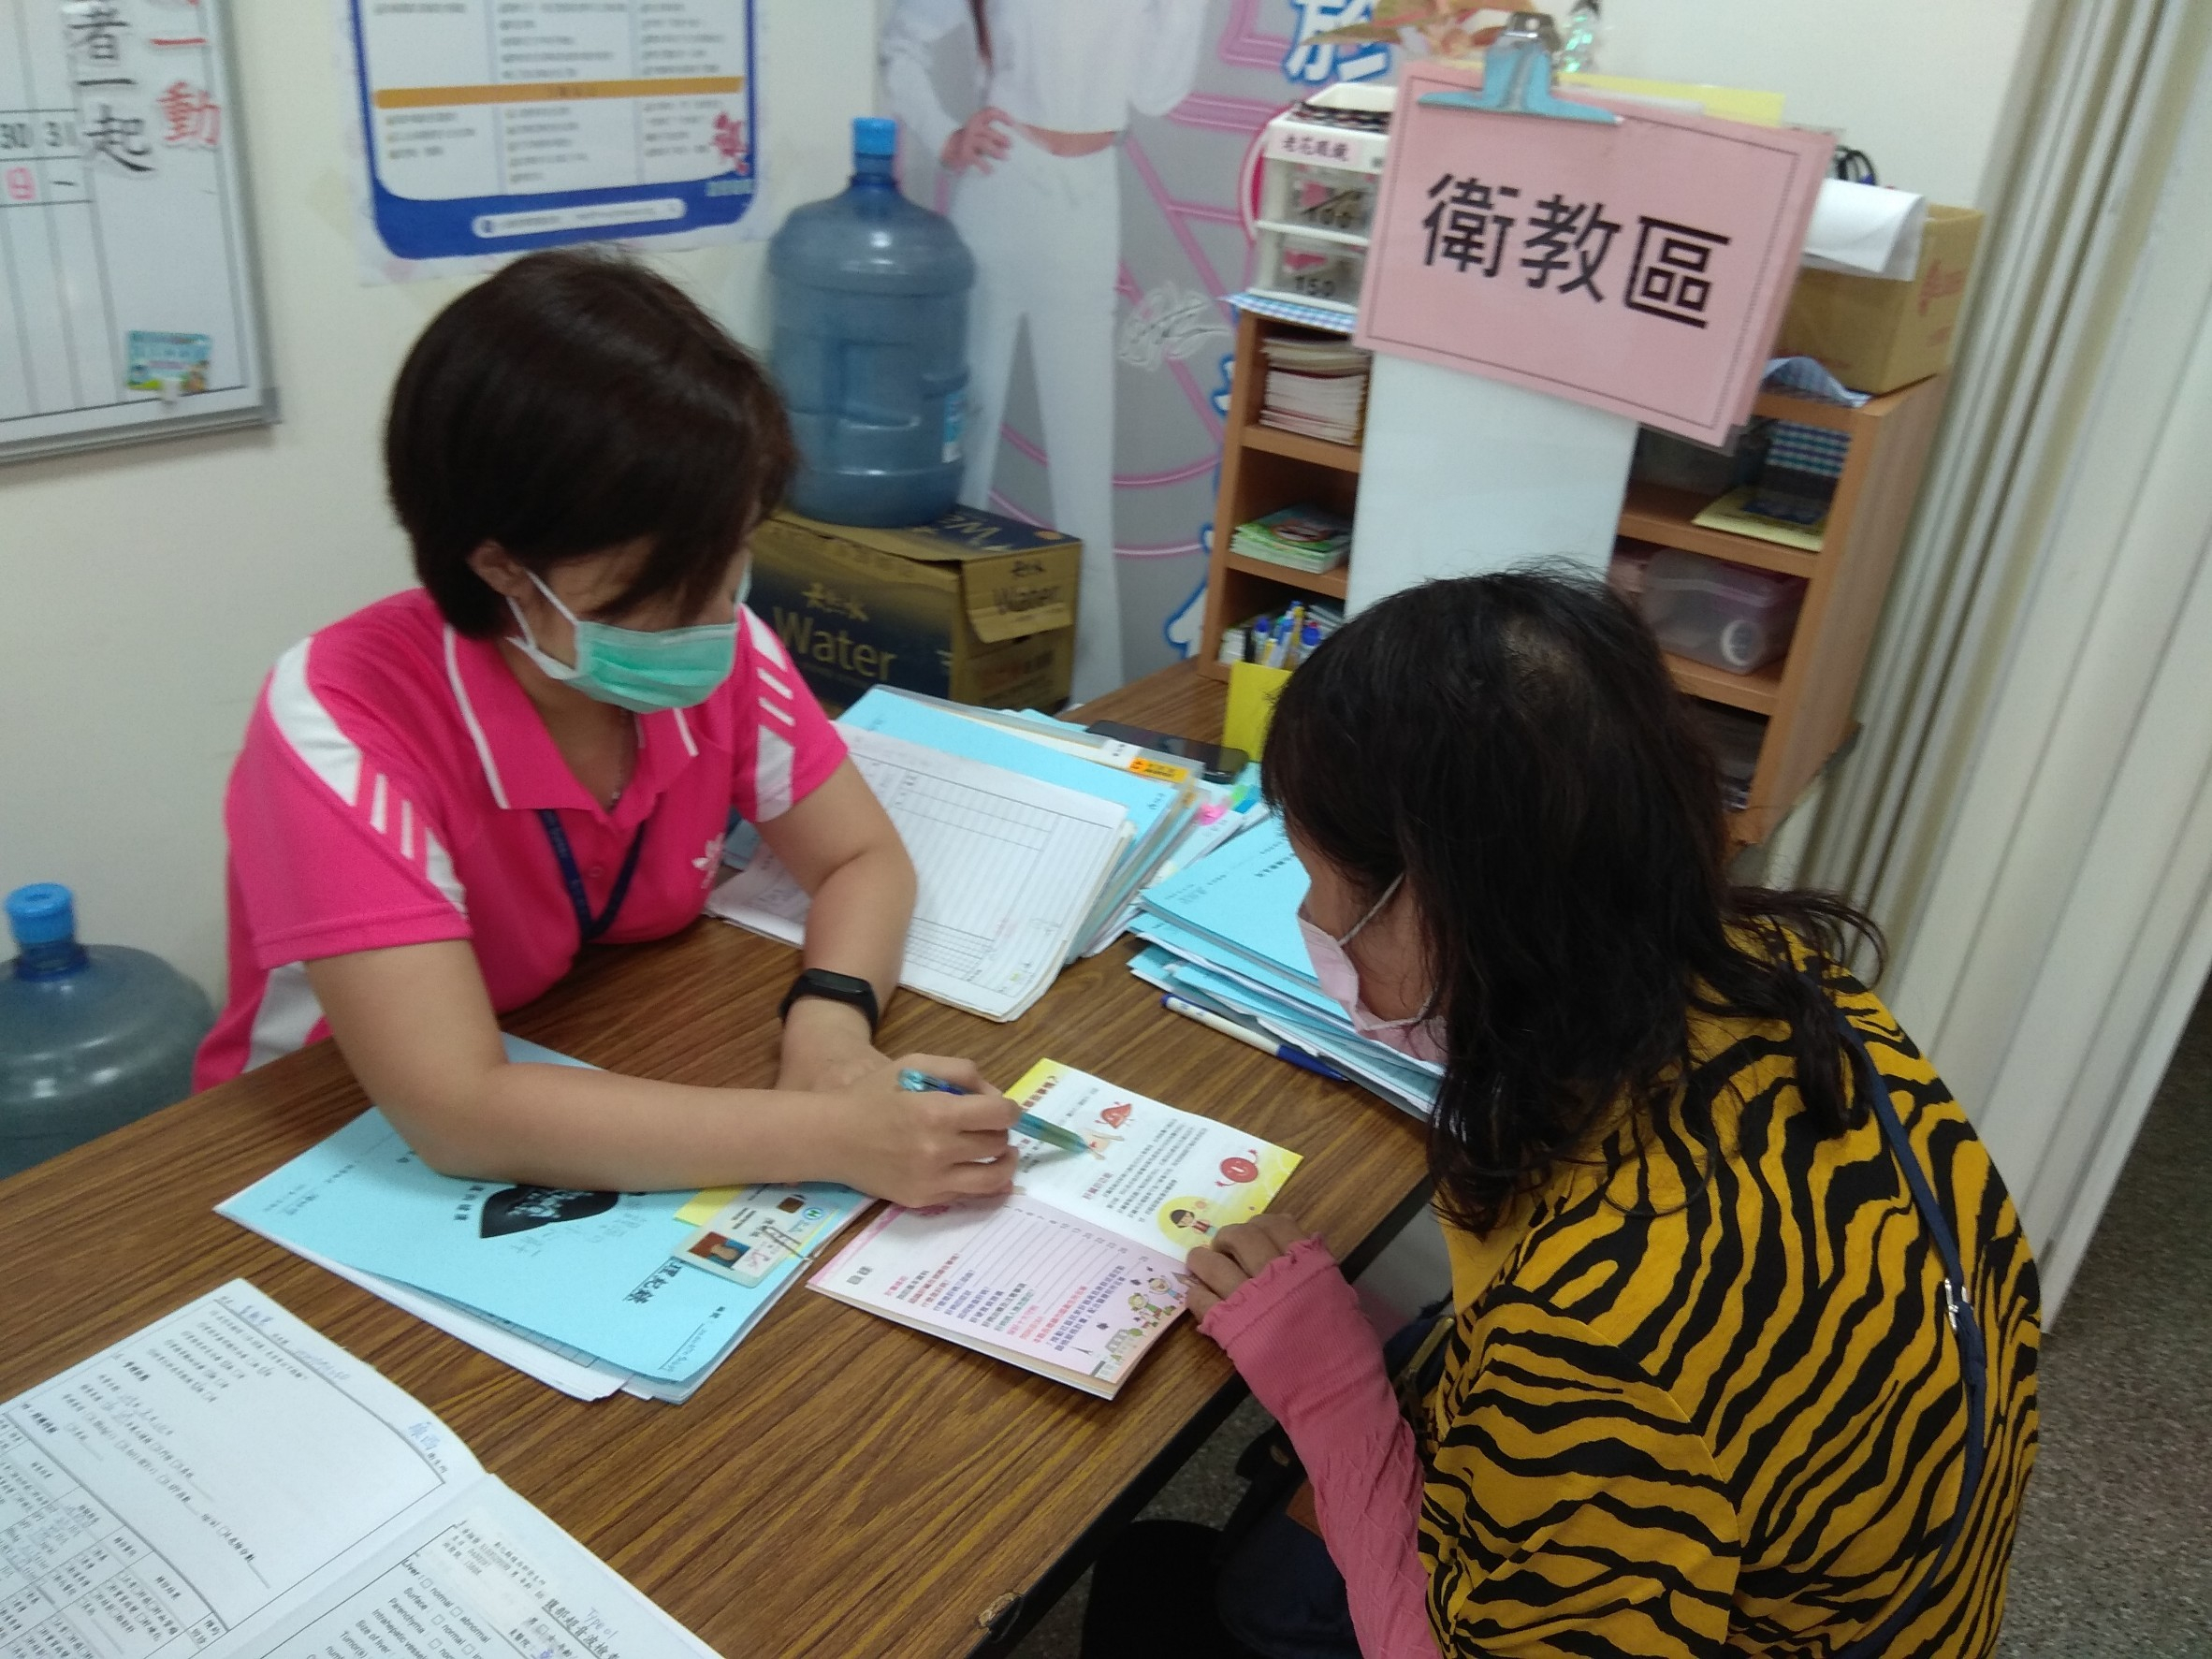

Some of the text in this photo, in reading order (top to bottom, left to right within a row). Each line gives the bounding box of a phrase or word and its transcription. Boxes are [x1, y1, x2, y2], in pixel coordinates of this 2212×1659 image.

[1422, 173, 1732, 329] 衛教區
[773, 606, 897, 681] Water
[371, 1608, 407, 1644] Intrahepatic
[388, 1597, 426, 1635] Parenchyma
[401, 1559, 491, 1643] Liver normal abnormal
[403, 1587, 466, 1646] Surface normal
